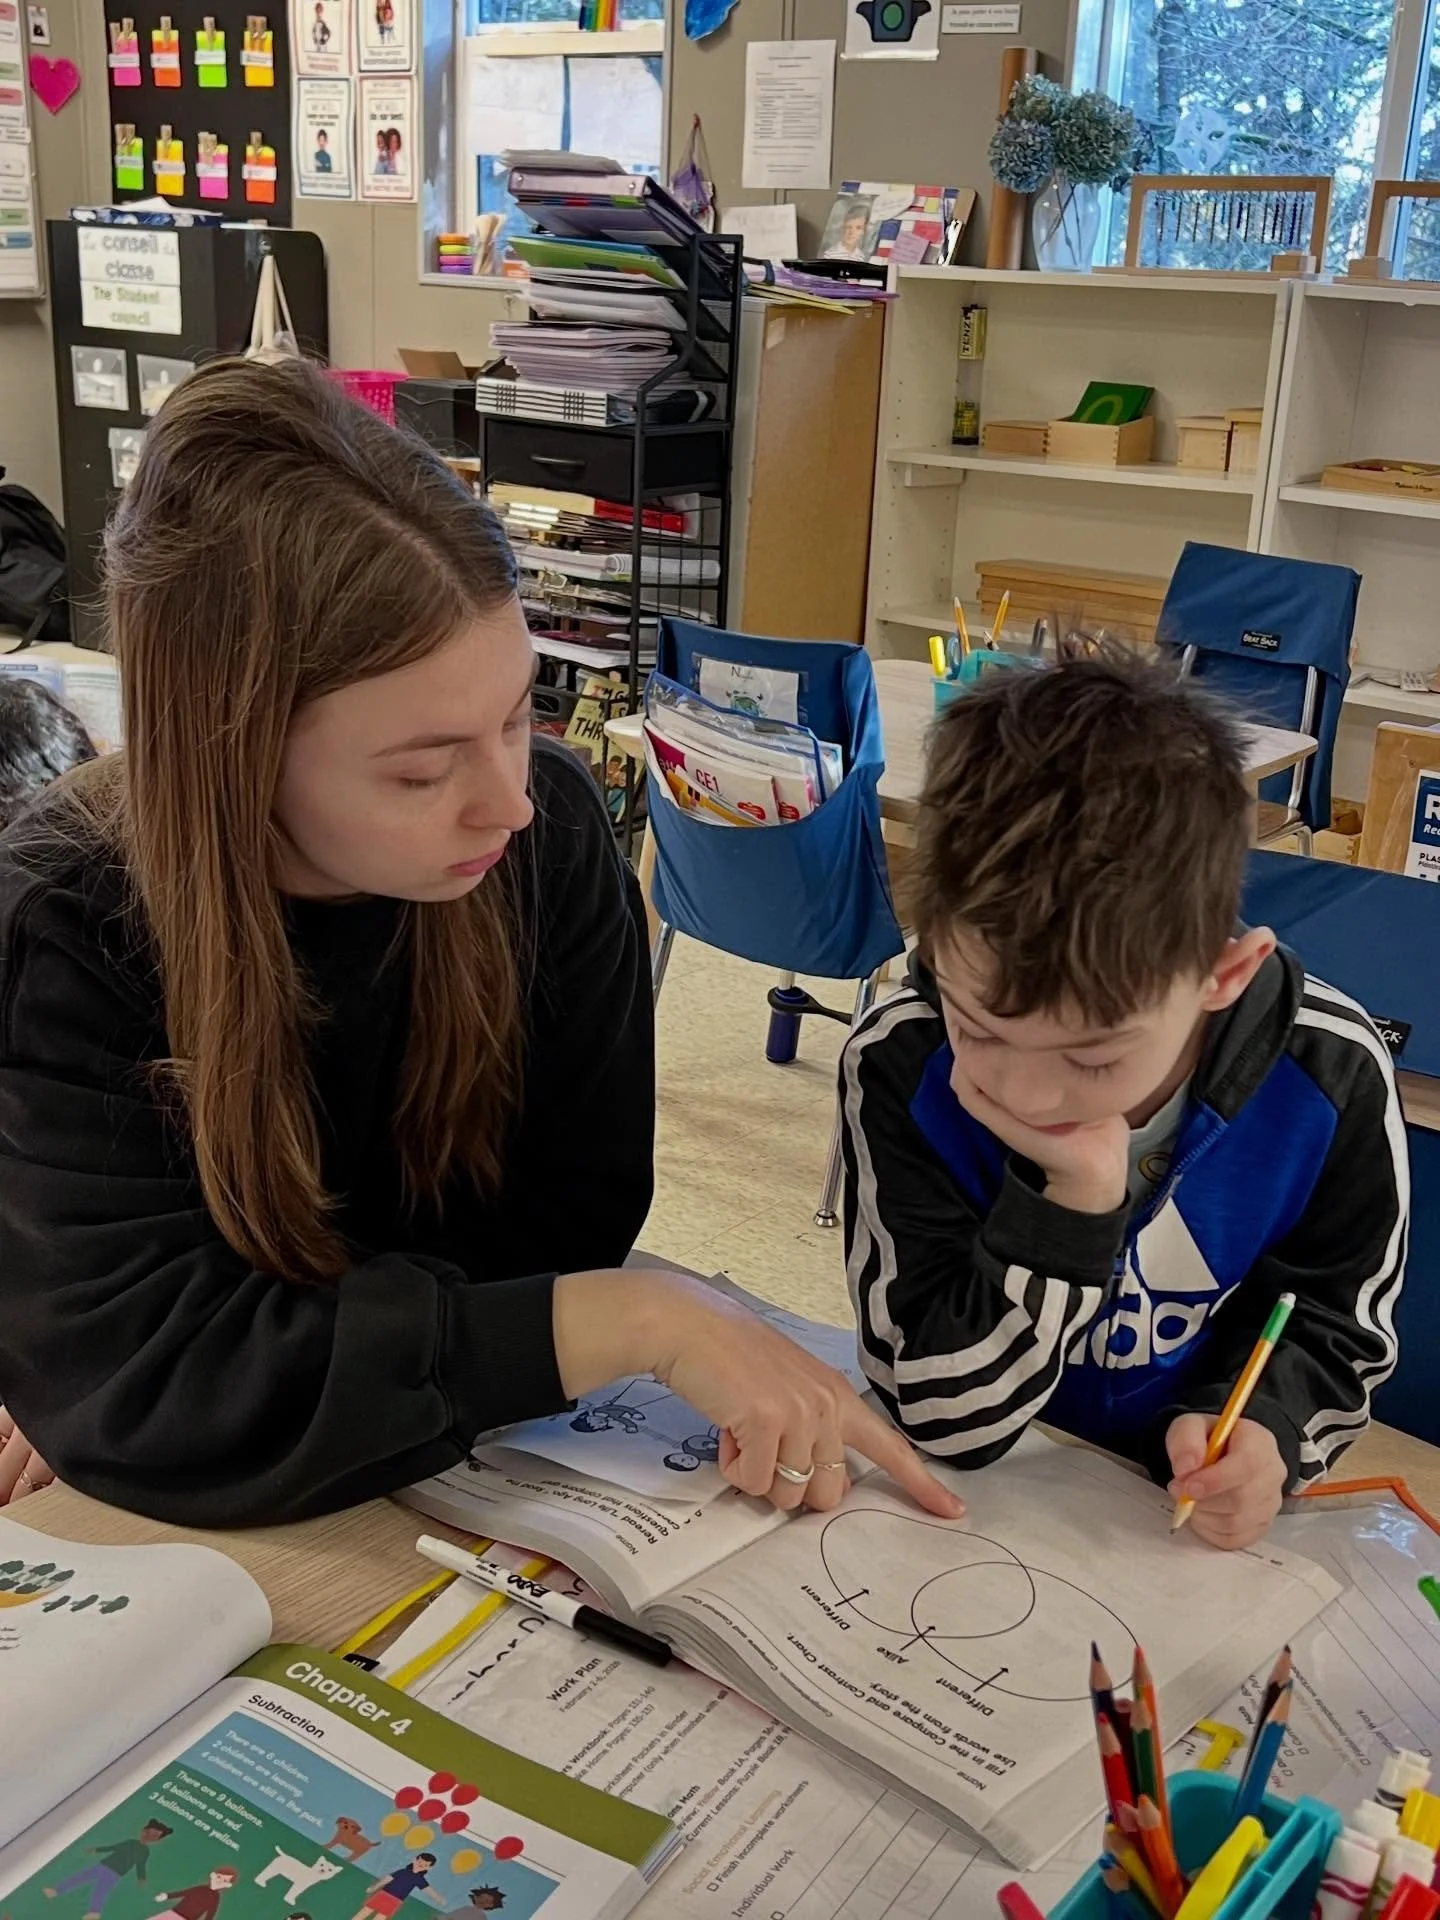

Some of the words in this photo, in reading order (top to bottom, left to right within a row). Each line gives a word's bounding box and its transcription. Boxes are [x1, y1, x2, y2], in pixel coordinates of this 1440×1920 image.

[621, 1515, 658, 1545] Reread
[625, 1503, 669, 1537] questions
[615, 1534, 639, 1555] Name
[800, 1584, 851, 1631] Different
[786, 1631, 817, 1663] Chart.
[876, 1646, 910, 1664] Alike
[546, 1677, 579, 1702] Work
[575, 1657, 602, 1678] Plan
[817, 1663, 866, 1699] Contrast
[869, 1681, 900, 1701] story.
[285, 1661, 391, 1723] Chapter
[388, 1718, 413, 1737] 4
[559, 1685, 593, 1712] February
[865, 1696, 891, 1711] and
[901, 1700, 922, 1715] the
[935, 1677, 995, 1717] Different
[248, 1694, 325, 1739] Subtraction
[892, 1709, 946, 1746] Compare
[922, 1712, 952, 1734] from
[226, 1729, 250, 1746] There
[249, 1744, 266, 1756] are
[948, 1743, 970, 1758] the
[952, 1732, 990, 1755] words
[220, 1744, 256, 1767] children
[255, 1764, 271, 1777] are
[971, 1755, 986, 1766] in
[984, 1763, 1007, 1776] Fill
[993, 1753, 1017, 1768] Use
[207, 1755, 243, 1778] children
[243, 1774, 259, 1788] are
[258, 1785, 278, 1799] still
[286, 1799, 302, 1814] the
[717, 1767, 737, 1786] Book
[956, 1769, 987, 1791] Name
[162, 1781, 173, 1790] 6
[169, 1784, 208, 1811] balloons
[207, 1807, 224, 1821] are
[222, 1817, 243, 1832] red.
[176, 1769, 201, 1788] There
[200, 1785, 217, 1797] are
[224, 1797, 264, 1828] balloons.
[679, 1785, 700, 1804] Math
[685, 1814, 713, 1842] Current
[710, 1785, 740, 1816] Lessons:
[736, 1763, 761, 1787] Purple
[757, 1745, 777, 1764] Book
[148, 1792, 159, 1801] 3
[156, 1796, 195, 1822] balloons
[194, 1818, 211, 1832] are
[208, 1829, 240, 1851] yellow.
[715, 1860, 741, 1883] Finish
[736, 1820, 775, 1860] incomplete
[773, 1780, 809, 1820] worksheets
[731, 1872, 775, 1918] Individual
[770, 1849, 796, 1872] Work
